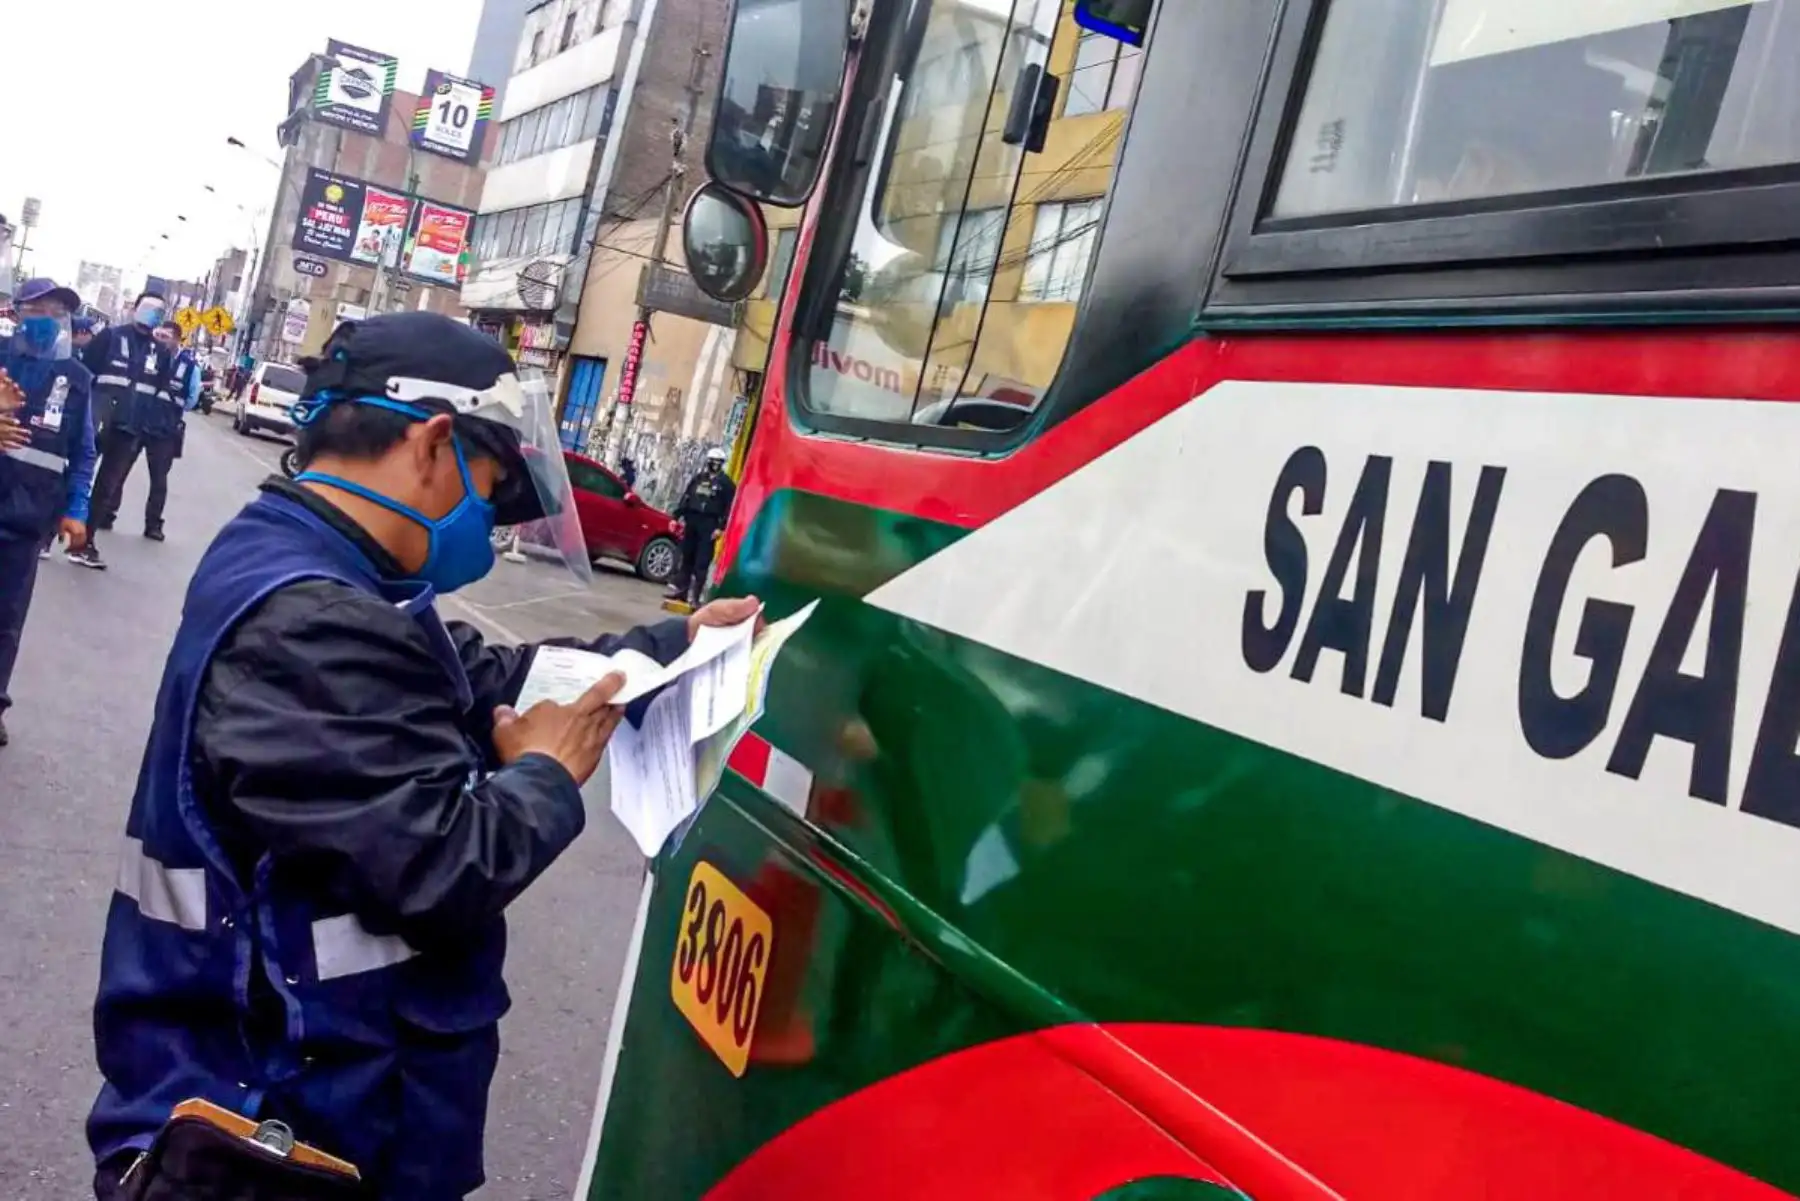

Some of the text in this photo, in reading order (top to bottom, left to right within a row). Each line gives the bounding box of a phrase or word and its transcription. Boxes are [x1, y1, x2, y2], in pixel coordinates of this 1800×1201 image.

[439, 101, 469, 130] 10
[1241, 445, 1507, 723] SAN
[679, 880, 764, 1048] 3806
